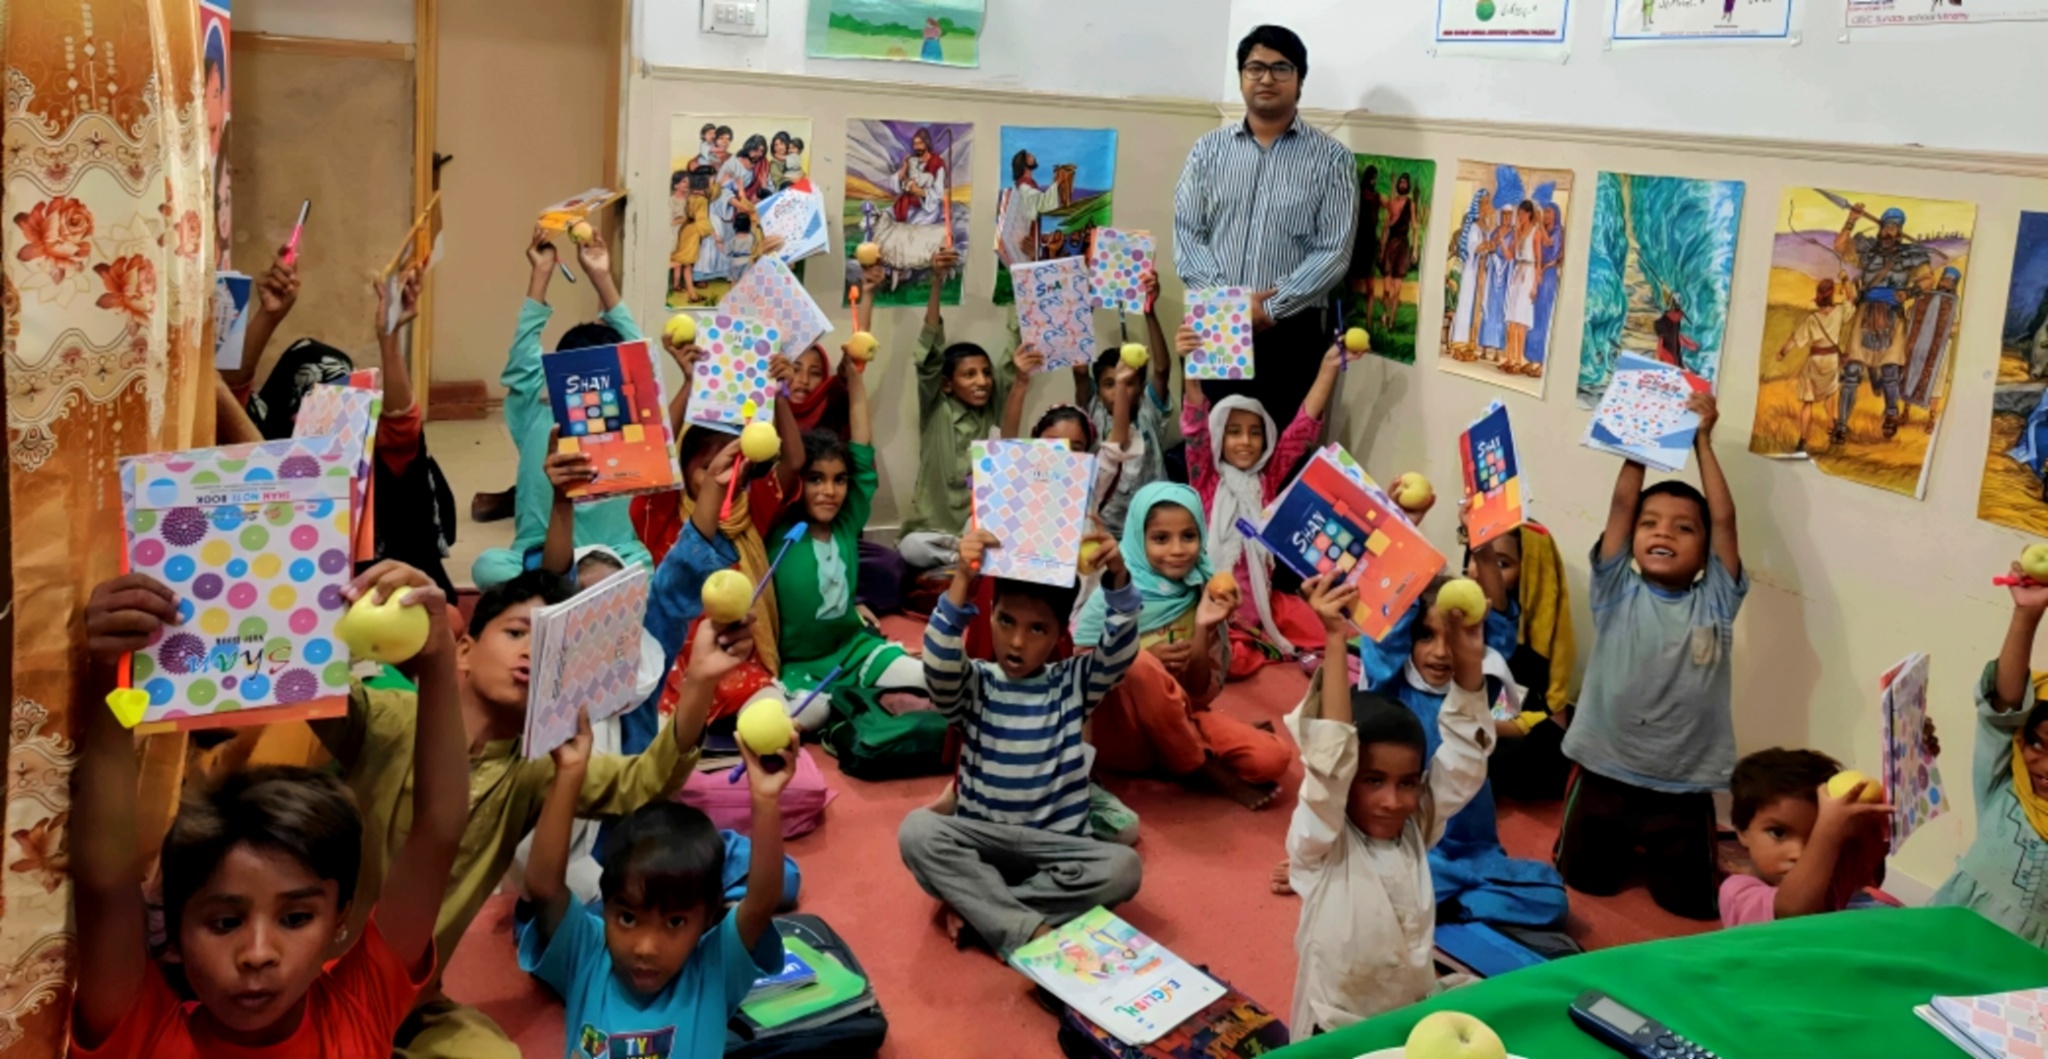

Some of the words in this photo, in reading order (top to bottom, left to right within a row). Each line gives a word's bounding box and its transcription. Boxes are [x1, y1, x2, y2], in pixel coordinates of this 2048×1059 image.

[565, 375, 611, 394] SHAN
[195, 494, 227, 504] BOOK
[1292, 510, 1326, 553] SHAN
